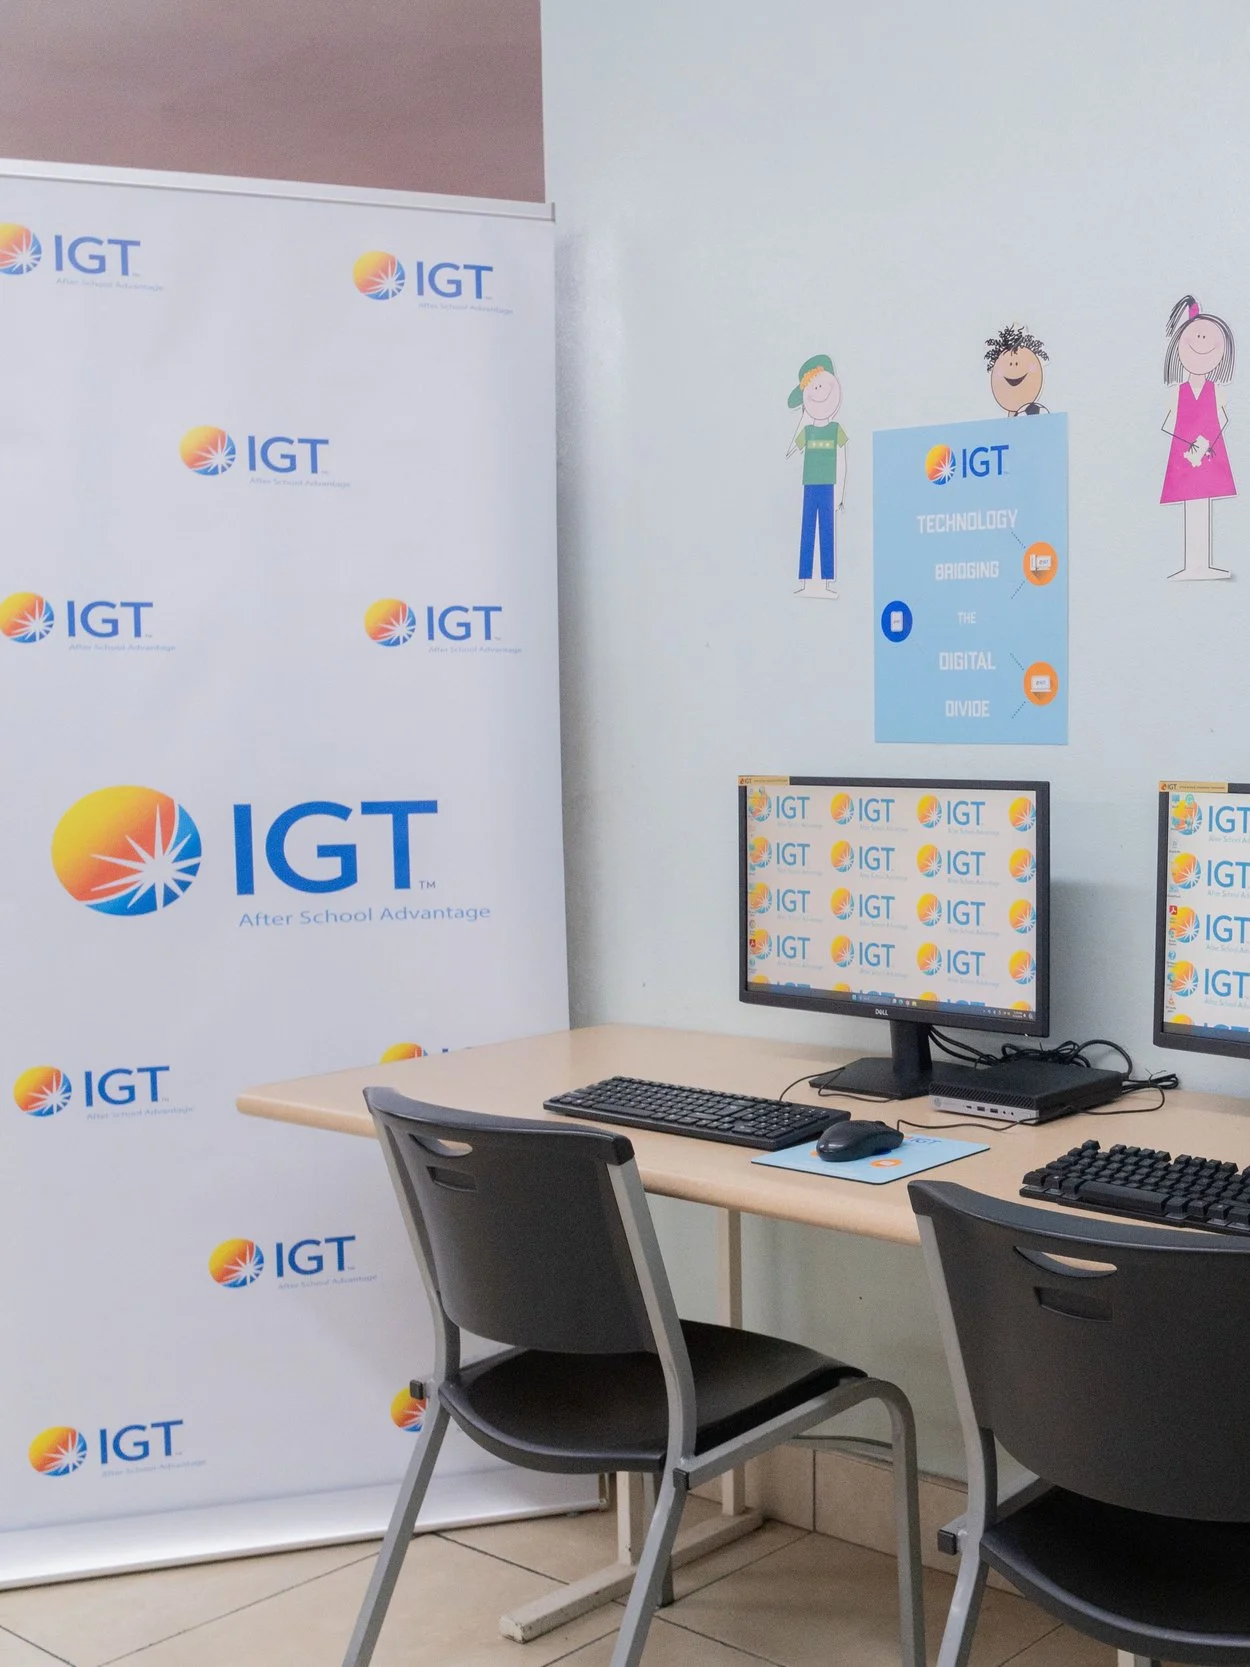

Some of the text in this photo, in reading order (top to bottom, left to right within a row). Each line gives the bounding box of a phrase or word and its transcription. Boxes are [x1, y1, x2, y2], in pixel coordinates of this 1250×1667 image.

[54, 235, 140, 276] IGT
[417, 261, 493, 299] IGT
[248, 434, 329, 474] IGT
[963, 445, 1009, 478] IGT
[917, 510, 1018, 533] TECHNOLOGY
[66, 600, 153, 638] IGT
[426, 605, 503, 641] IGT
[958, 612, 976, 624] THE
[939, 652, 996, 671] DIGITAL
[946, 700, 989, 717] DIVIDE
[776, 796, 809, 819] IGT
[858, 798, 895, 823] IGT
[946, 800, 986, 826] IGT
[233, 800, 439, 896] IGT
[776, 843, 809, 866] IGT
[859, 846, 894, 872] IGT
[946, 850, 985, 876] IGT
[776, 889, 810, 913] IGT
[859, 895, 894, 920] IGT
[947, 900, 985, 926] IGT
[239, 906, 490, 927] After School Advantage
[1206, 915, 1250, 943] IGT
[777, 935, 809, 959] IGT
[859, 943, 894, 968] IGT
[946, 950, 985, 976] IGT
[1204, 969, 1249, 998] IGT
[84, 1065, 170, 1108] IGT
[275, 1236, 356, 1279] IGT
[99, 1420, 183, 1466] IGT
